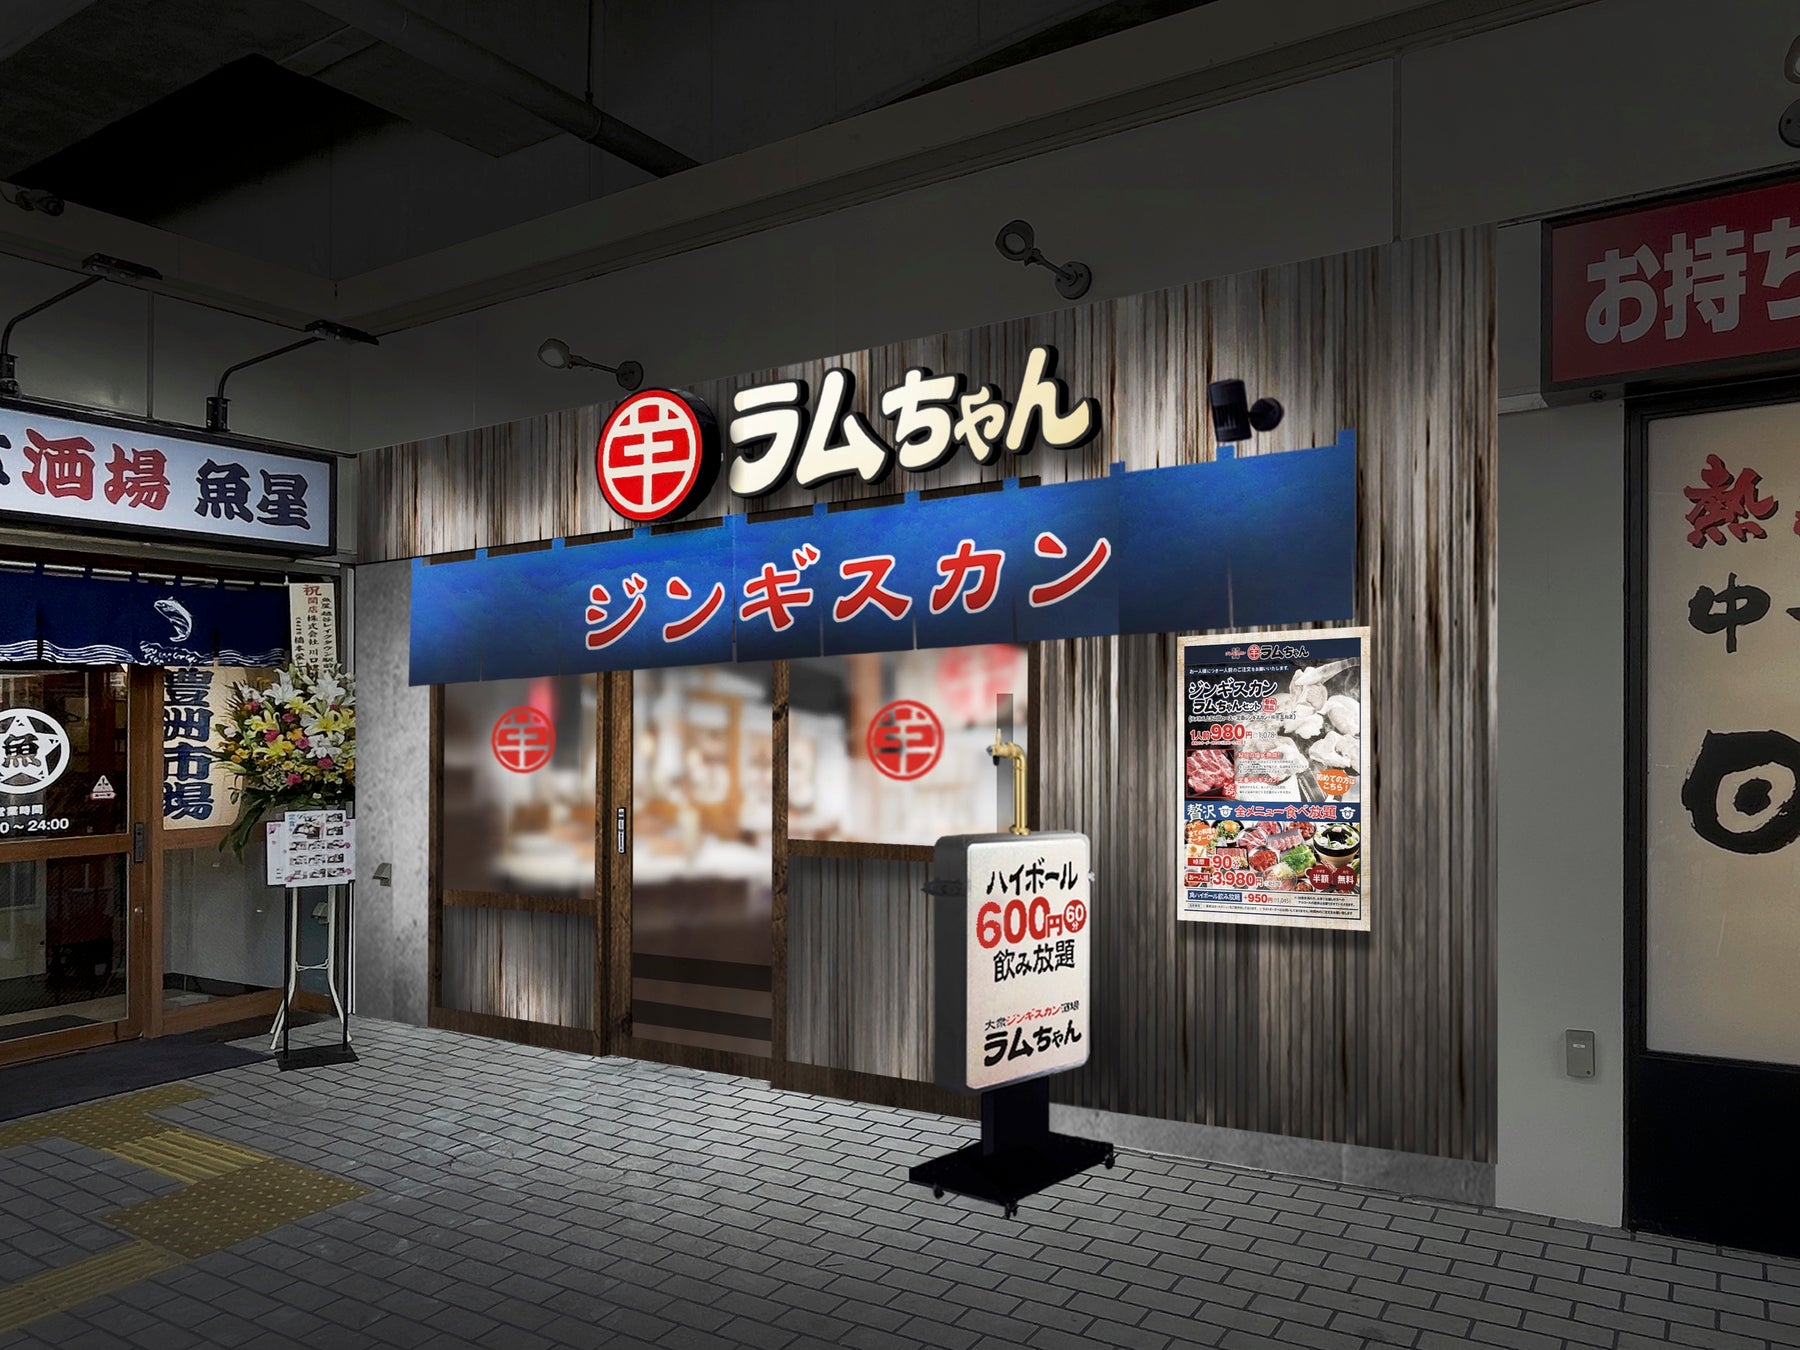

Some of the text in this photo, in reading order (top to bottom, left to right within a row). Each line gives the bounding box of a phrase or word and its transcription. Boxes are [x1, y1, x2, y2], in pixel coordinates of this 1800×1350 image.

[728, 344, 1094, 497] ラムちゃん
[0, 428, 311, 530] 酒場 魚星
[1684, 454, 1800, 549] 熱
[585, 531, 1112, 651] ジンギスカン
[1189, 677, 1278, 699] ジンギスカン
[1192, 698, 1262, 714] ラムちゃんセット
[1234, 804, 1338, 820] 全メニュー食べ放題
[986, 857, 1079, 896] ハイボール
[976, 896, 1063, 949] 600円
[993, 939, 1075, 983] 飲み放題
[983, 1019, 1082, 1067] ラムちゃん
